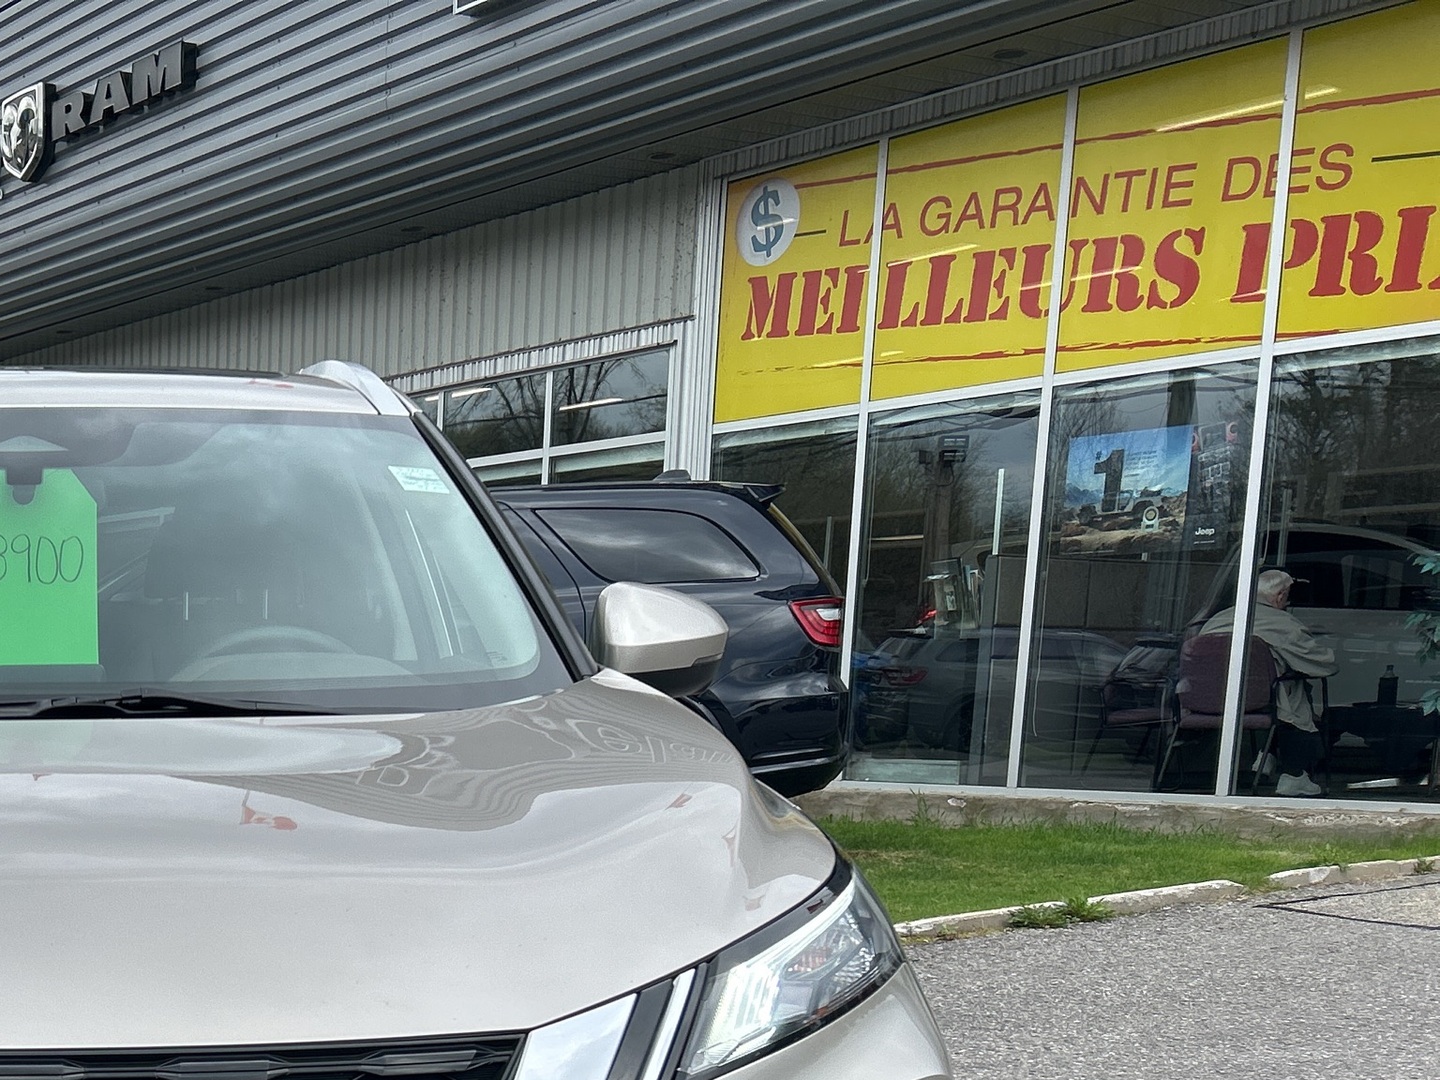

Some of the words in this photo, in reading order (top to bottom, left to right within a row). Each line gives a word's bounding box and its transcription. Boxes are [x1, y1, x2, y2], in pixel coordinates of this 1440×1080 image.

[51, 40, 183, 141] RAM
[839, 202, 903, 247] LA
[919, 162, 1198, 237] GARANTIE
[1221, 142, 1354, 202] DES
[740, 226, 1206, 341] MEILLEURS
[1230, 205, 1440, 303] PRI
